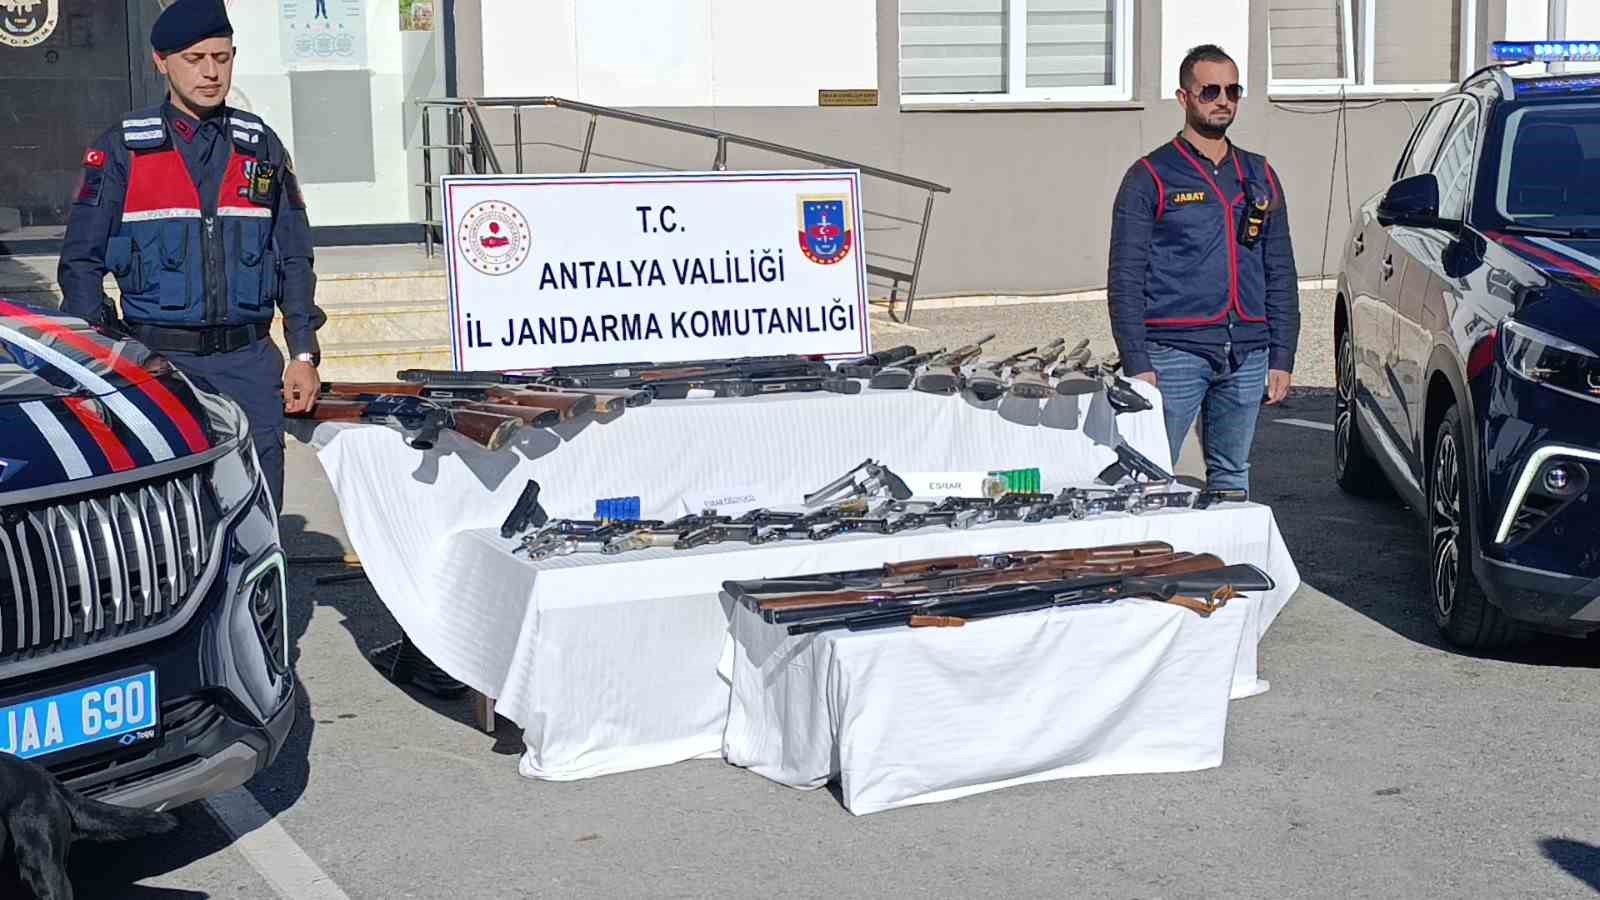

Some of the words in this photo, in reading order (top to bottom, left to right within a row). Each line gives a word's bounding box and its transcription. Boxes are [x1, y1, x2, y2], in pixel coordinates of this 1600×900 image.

[636, 206, 684, 232] T.C.
[539, 260, 665, 290] ANTALYA
[673, 249, 784, 284] VALİLİĞİ
[467, 313, 492, 347] İL
[502, 313, 662, 346] JANDARMA
[672, 299, 854, 338] KOMUTANLIĞI
[82, 680, 145, 736] 690
